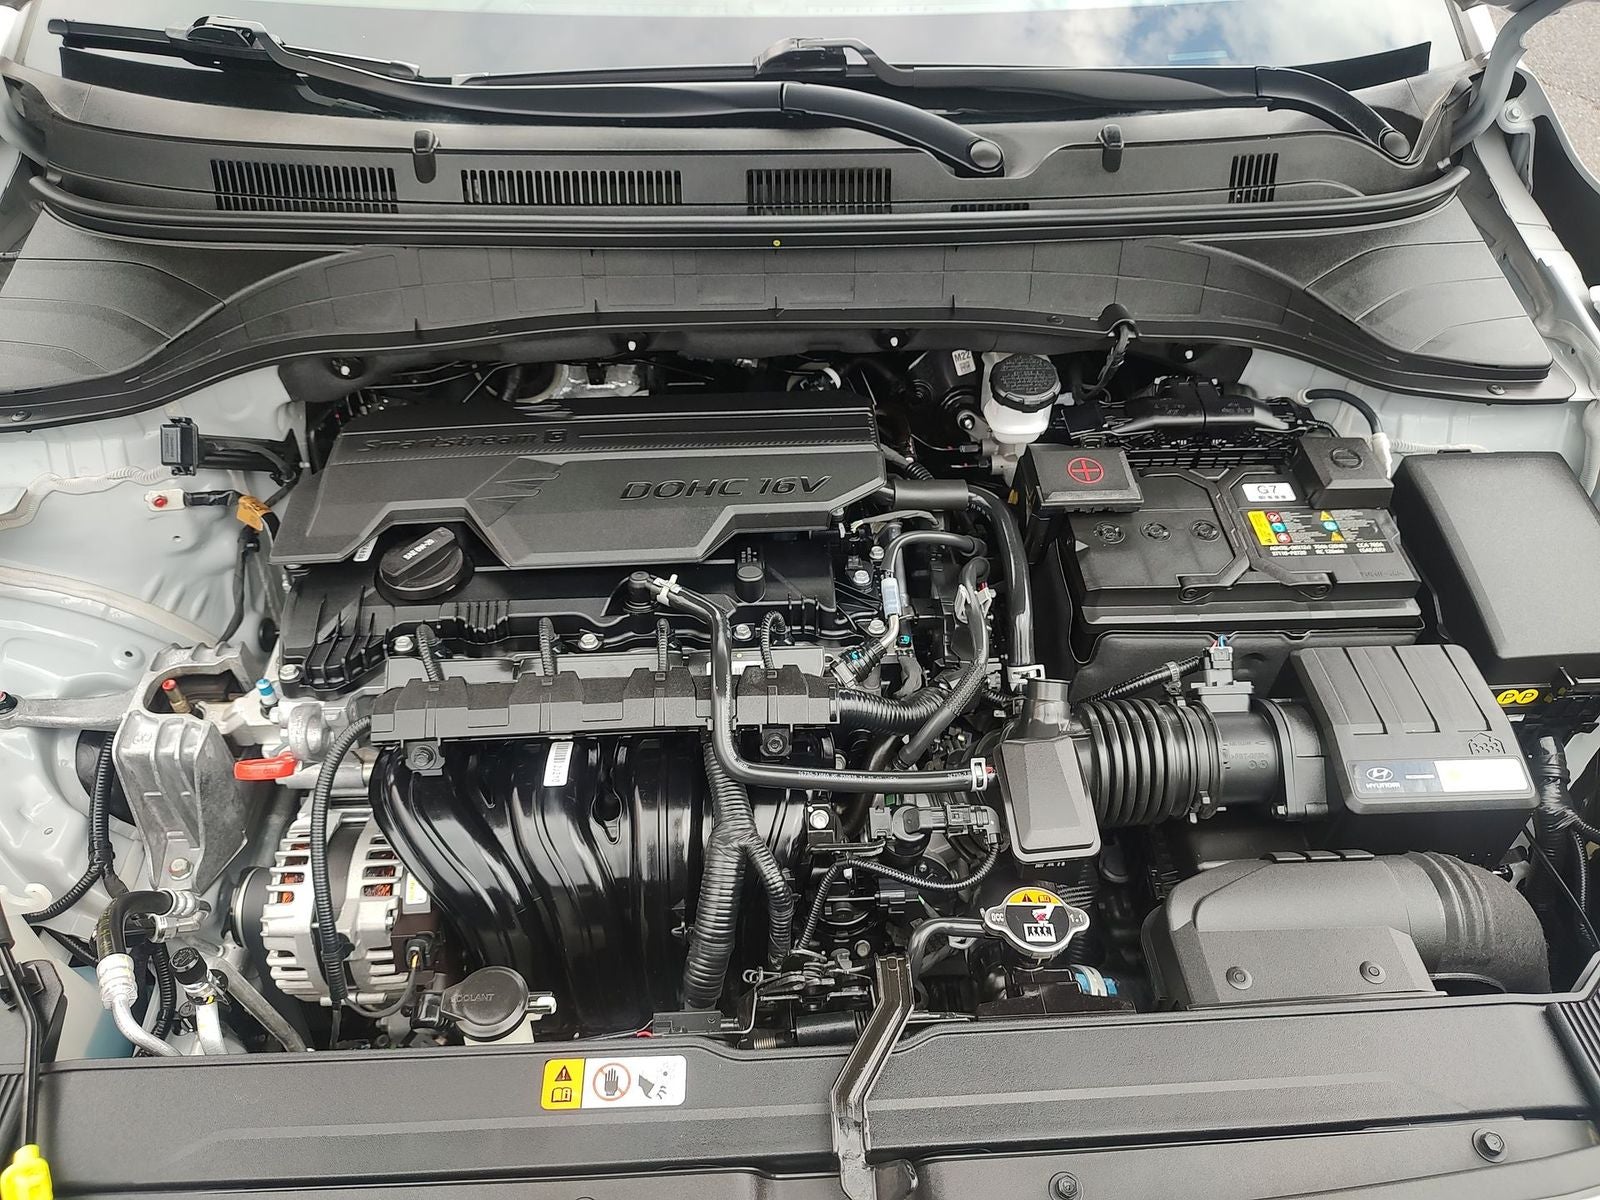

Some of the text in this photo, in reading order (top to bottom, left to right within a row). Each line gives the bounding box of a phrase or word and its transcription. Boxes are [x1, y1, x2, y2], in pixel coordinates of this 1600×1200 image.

[954, 350, 971, 362] M22
[620, 475, 832, 500] DOHC 16V
[1257, 485, 1277, 494] G7
